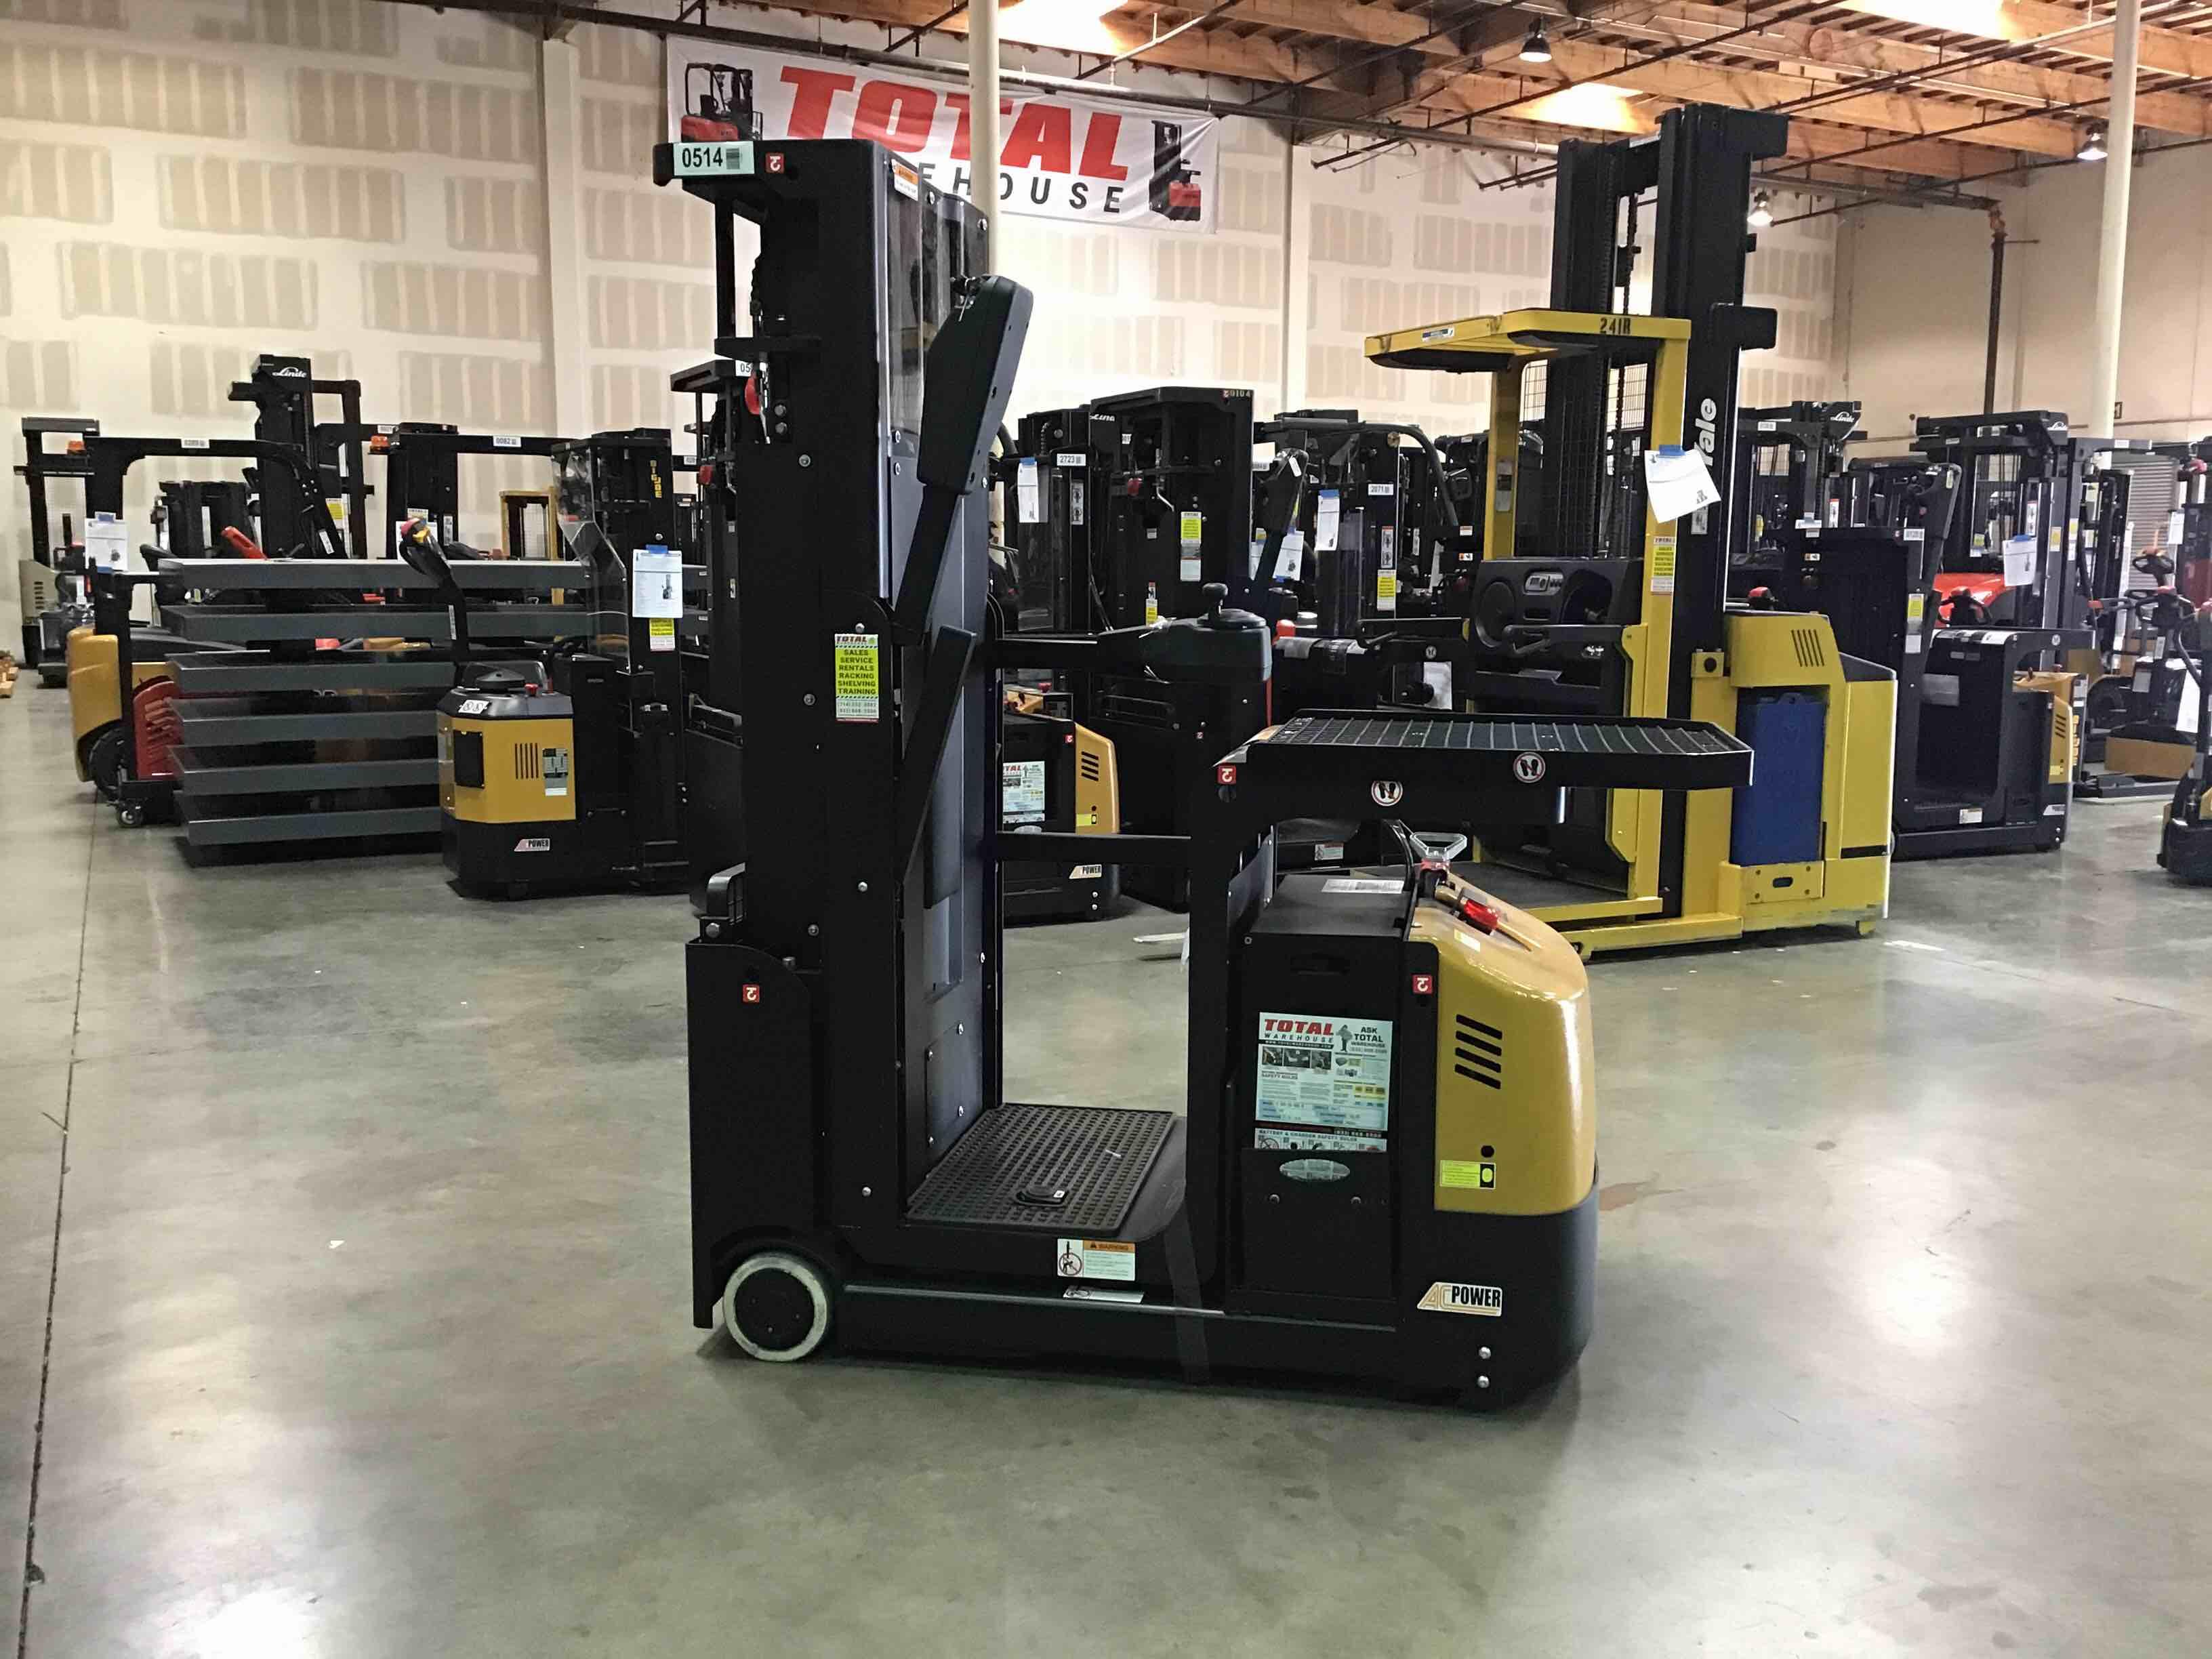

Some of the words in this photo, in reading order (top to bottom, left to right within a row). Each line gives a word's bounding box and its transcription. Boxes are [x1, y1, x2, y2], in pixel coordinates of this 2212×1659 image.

[780, 66, 1128, 181] TOTAL
[682, 147, 723, 167] 0514
[272, 367, 307, 377] Linde
[1694, 398, 1717, 467] Yale
[1265, 1019, 1334, 1036] TOTAL
[1265, 1032, 1333, 1043] WAREHOUSE
[1355, 1033, 1384, 1042] TOTAL
[1452, 1286, 1501, 1307] POWER
